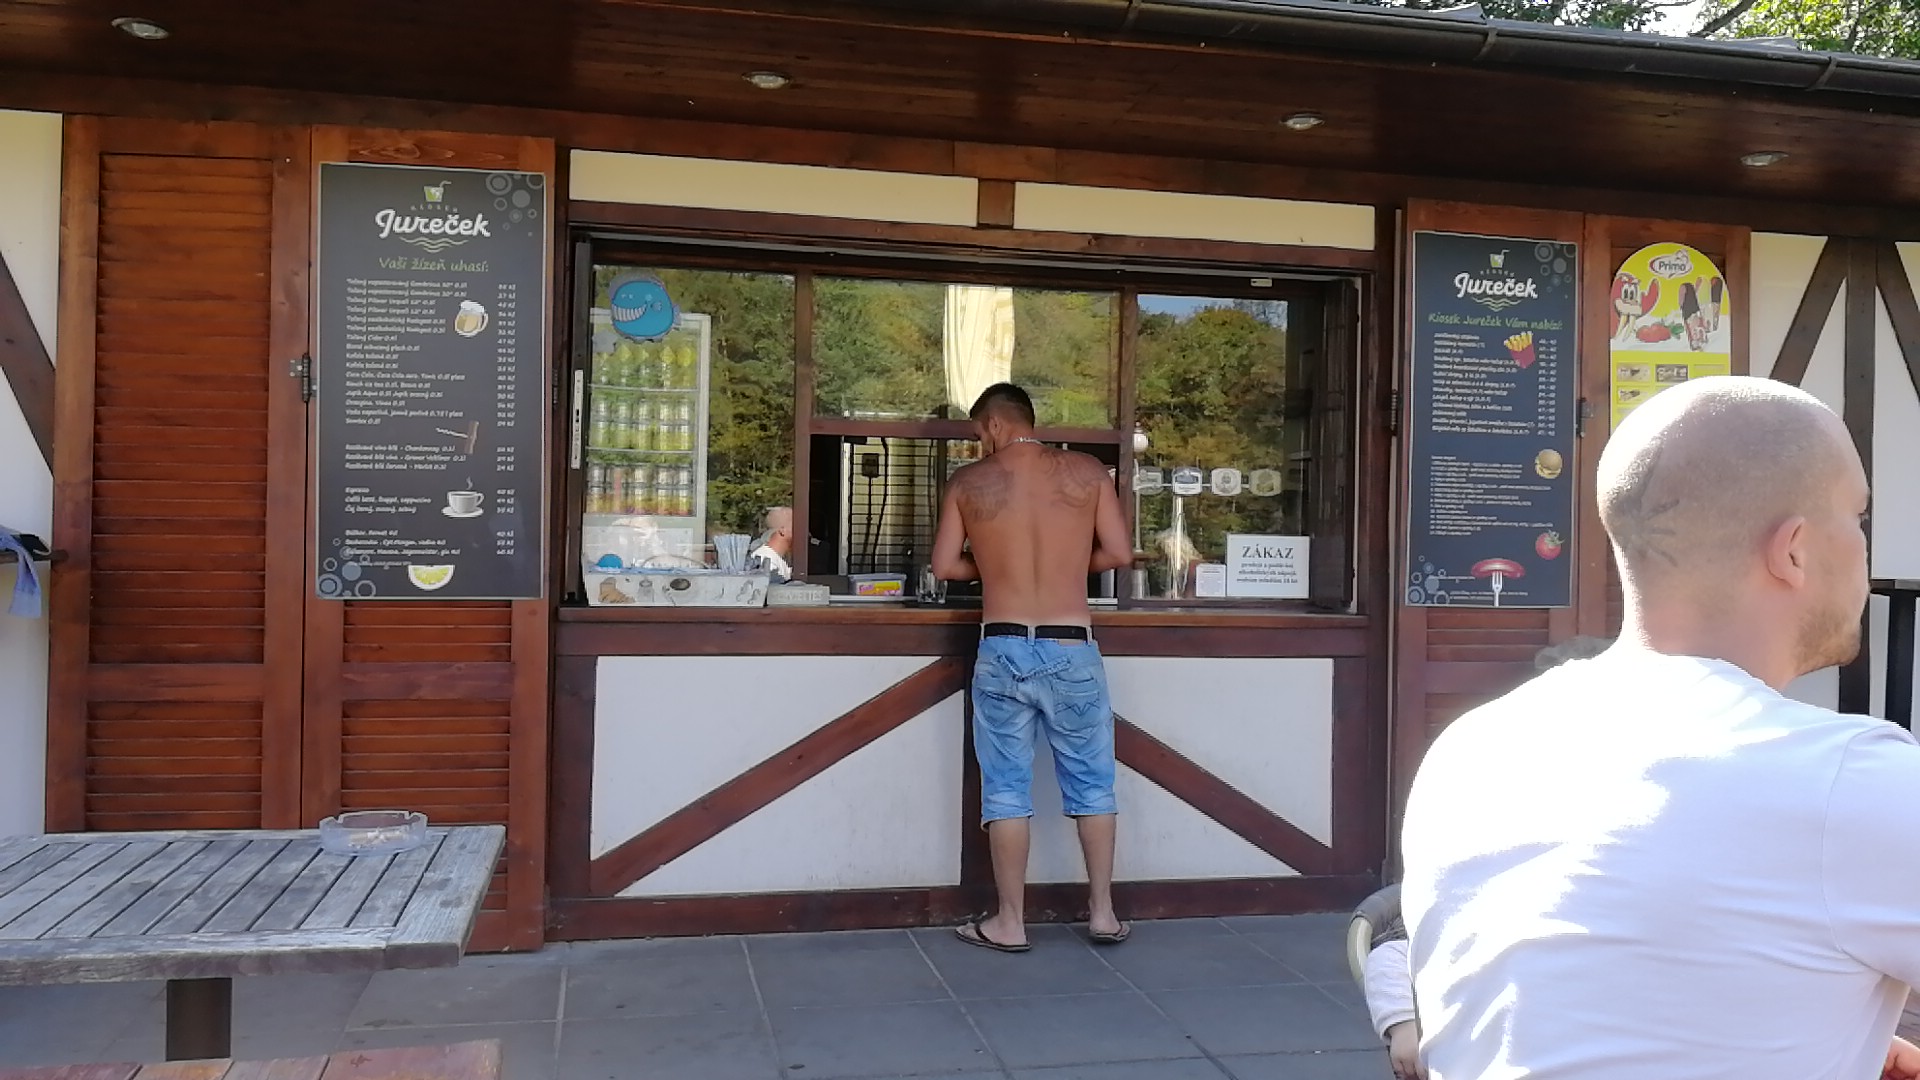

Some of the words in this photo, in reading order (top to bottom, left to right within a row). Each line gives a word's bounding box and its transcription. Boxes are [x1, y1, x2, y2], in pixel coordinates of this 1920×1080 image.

[375, 208, 491, 239] Jureček
[411, 256, 446, 271] žízeň
[450, 259, 489, 272] uhasí:
[1658, 260, 1686, 272] Primo
[1454, 272, 1538, 299] Jureček
[1428, 312, 1461, 324] Kiosek
[1463, 315, 1502, 327] Jureček
[1505, 317, 1528, 328] Vám
[1242, 543, 1294, 560] ZÁKAZ
